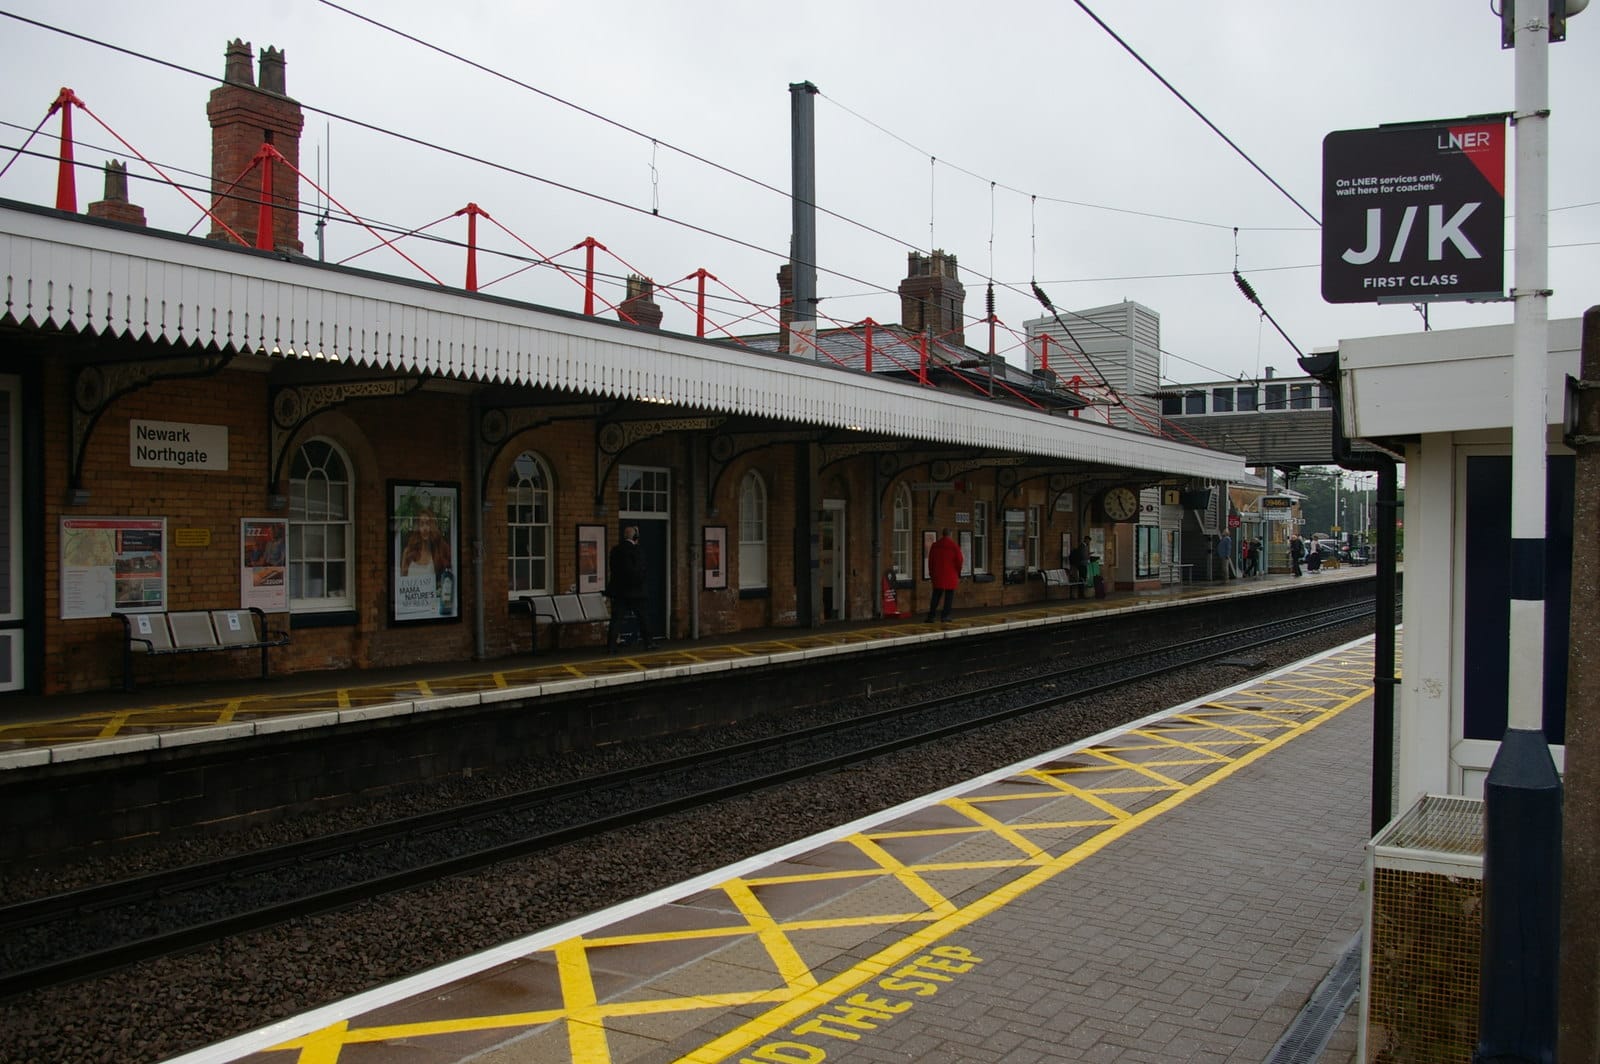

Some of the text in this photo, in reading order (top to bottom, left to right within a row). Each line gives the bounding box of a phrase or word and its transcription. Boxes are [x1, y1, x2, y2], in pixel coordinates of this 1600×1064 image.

[1437, 132, 1490, 149] LNER
[1336, 173, 1442, 187] On LNER services only,
[1336, 183, 1435, 196] wait here for coaches
[1341, 202, 1482, 265] J/K
[1363, 274, 1459, 288] FIRST CLASS
[136, 425, 190, 442] Newark
[136, 446, 208, 465] Northgate
[1168, 493, 1174, 503] 1
[399, 586, 421, 594] MAMA
[791, 993, 914, 1041] THE
[878, 945, 983, 997] STEP
